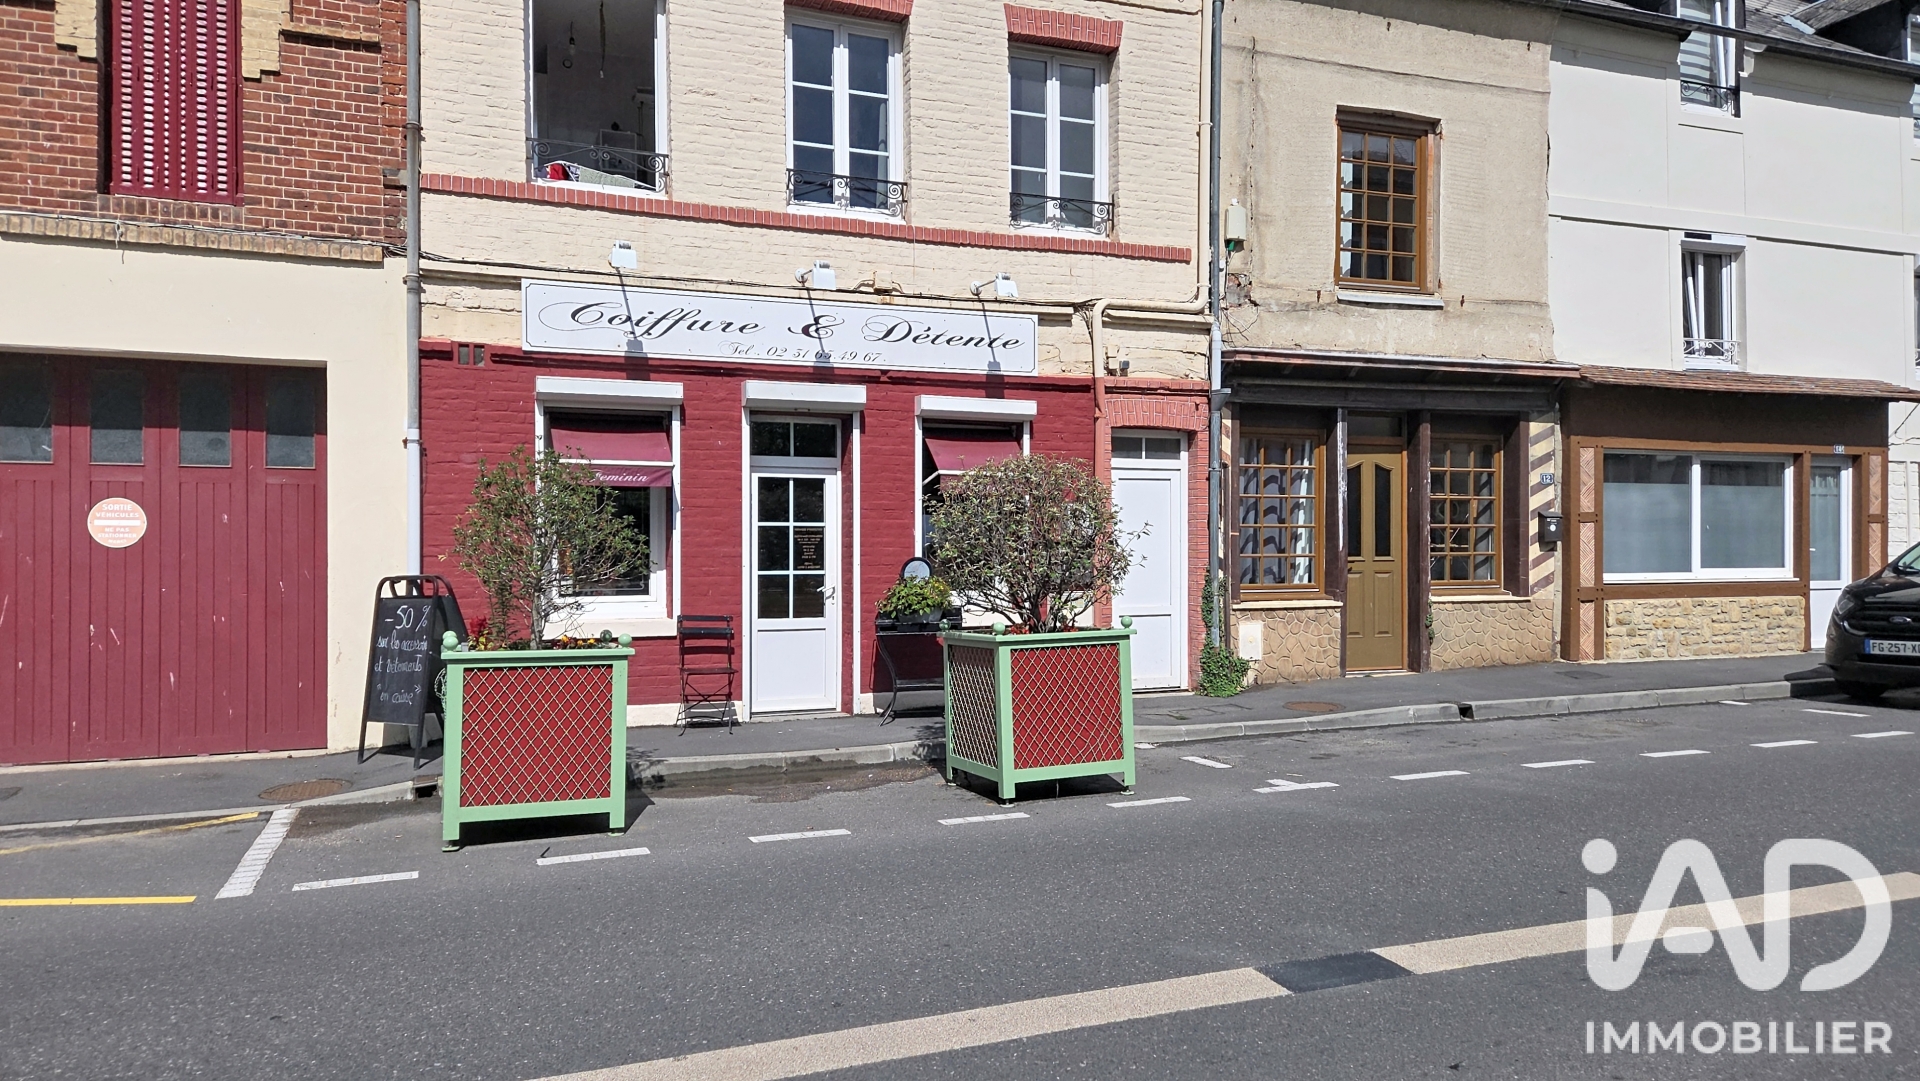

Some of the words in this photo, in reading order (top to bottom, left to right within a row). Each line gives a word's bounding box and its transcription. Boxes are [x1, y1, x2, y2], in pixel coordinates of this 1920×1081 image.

[538, 301, 766, 340] Coiffure
[787, 314, 846, 340] &
[861, 314, 1026, 350] Détente
[766, 346, 788, 358] 02
[102, 503, 133, 511] SORTIE
[384, 605, 414, 630] -50
[376, 635, 389, 649] sur
[374, 655, 383, 672] et
